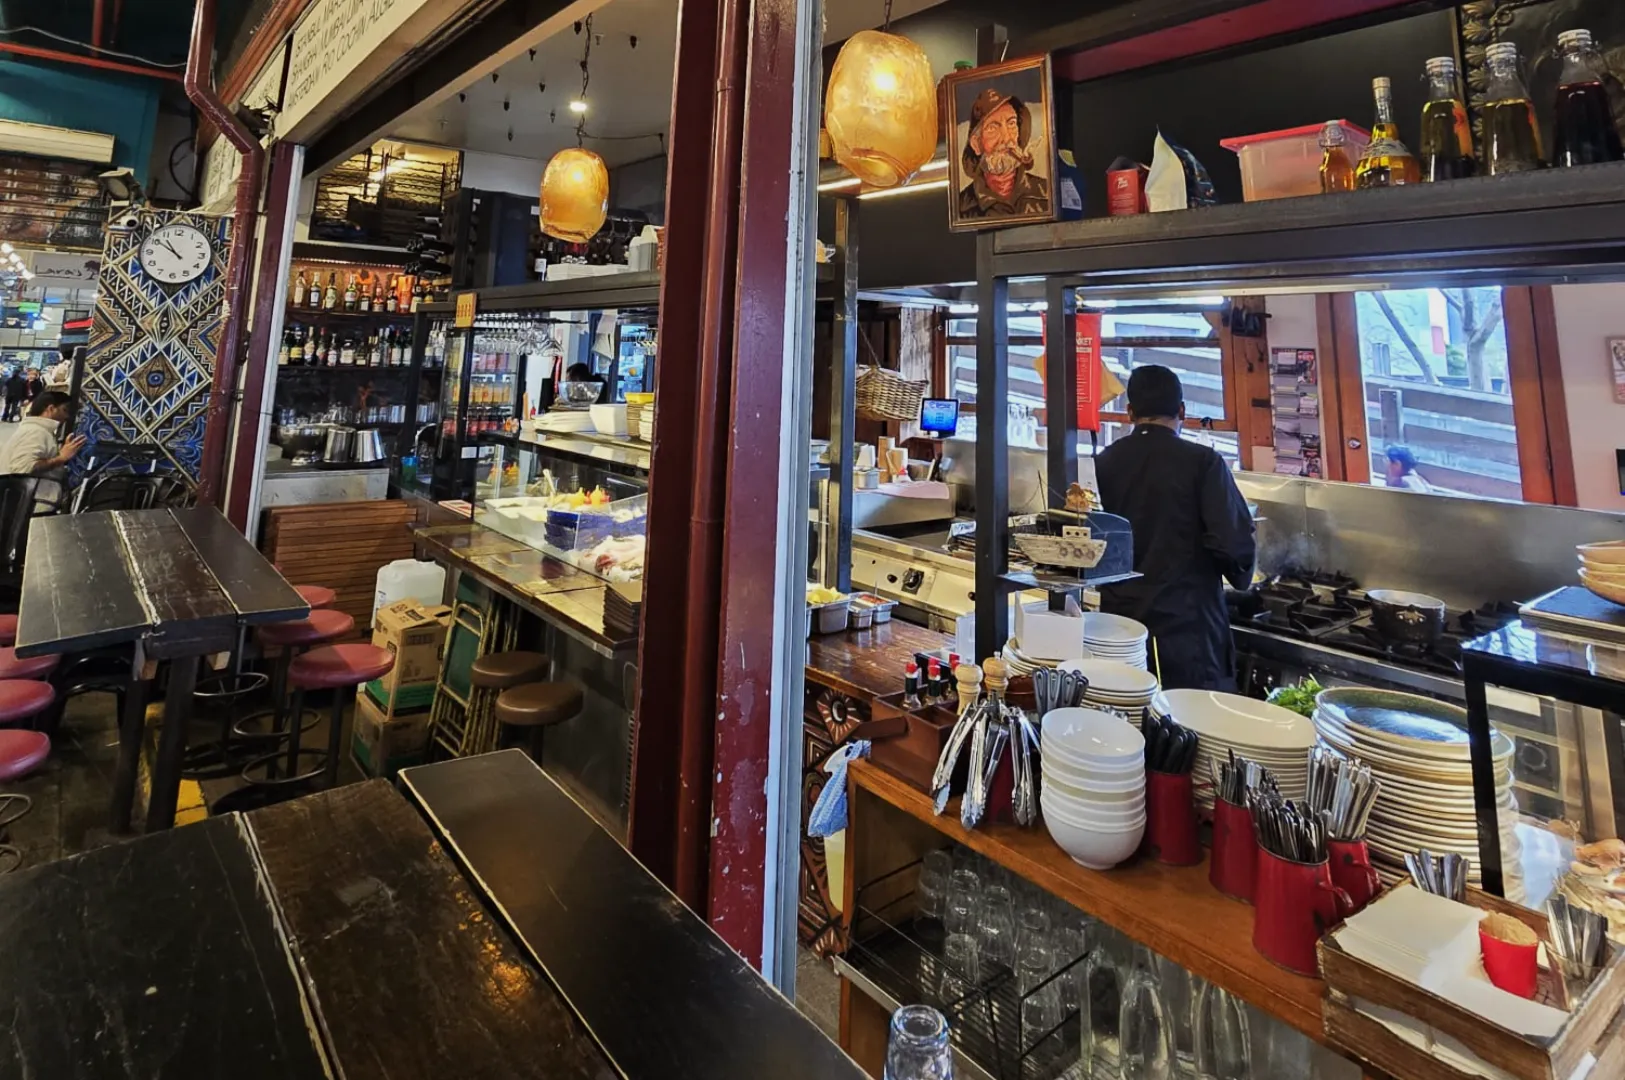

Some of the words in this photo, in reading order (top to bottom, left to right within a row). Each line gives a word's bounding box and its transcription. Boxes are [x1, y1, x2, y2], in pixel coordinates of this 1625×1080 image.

[321, 47, 336, 78] RIO
[336, 12, 368, 62] COCHIN
[162, 231, 170, 239] 11
[174, 229, 184, 237] 12
[195, 241, 203, 249] 2
[197, 252, 206, 260] 3
[192, 262, 200, 270] 4
[157, 268, 164, 276] 7
